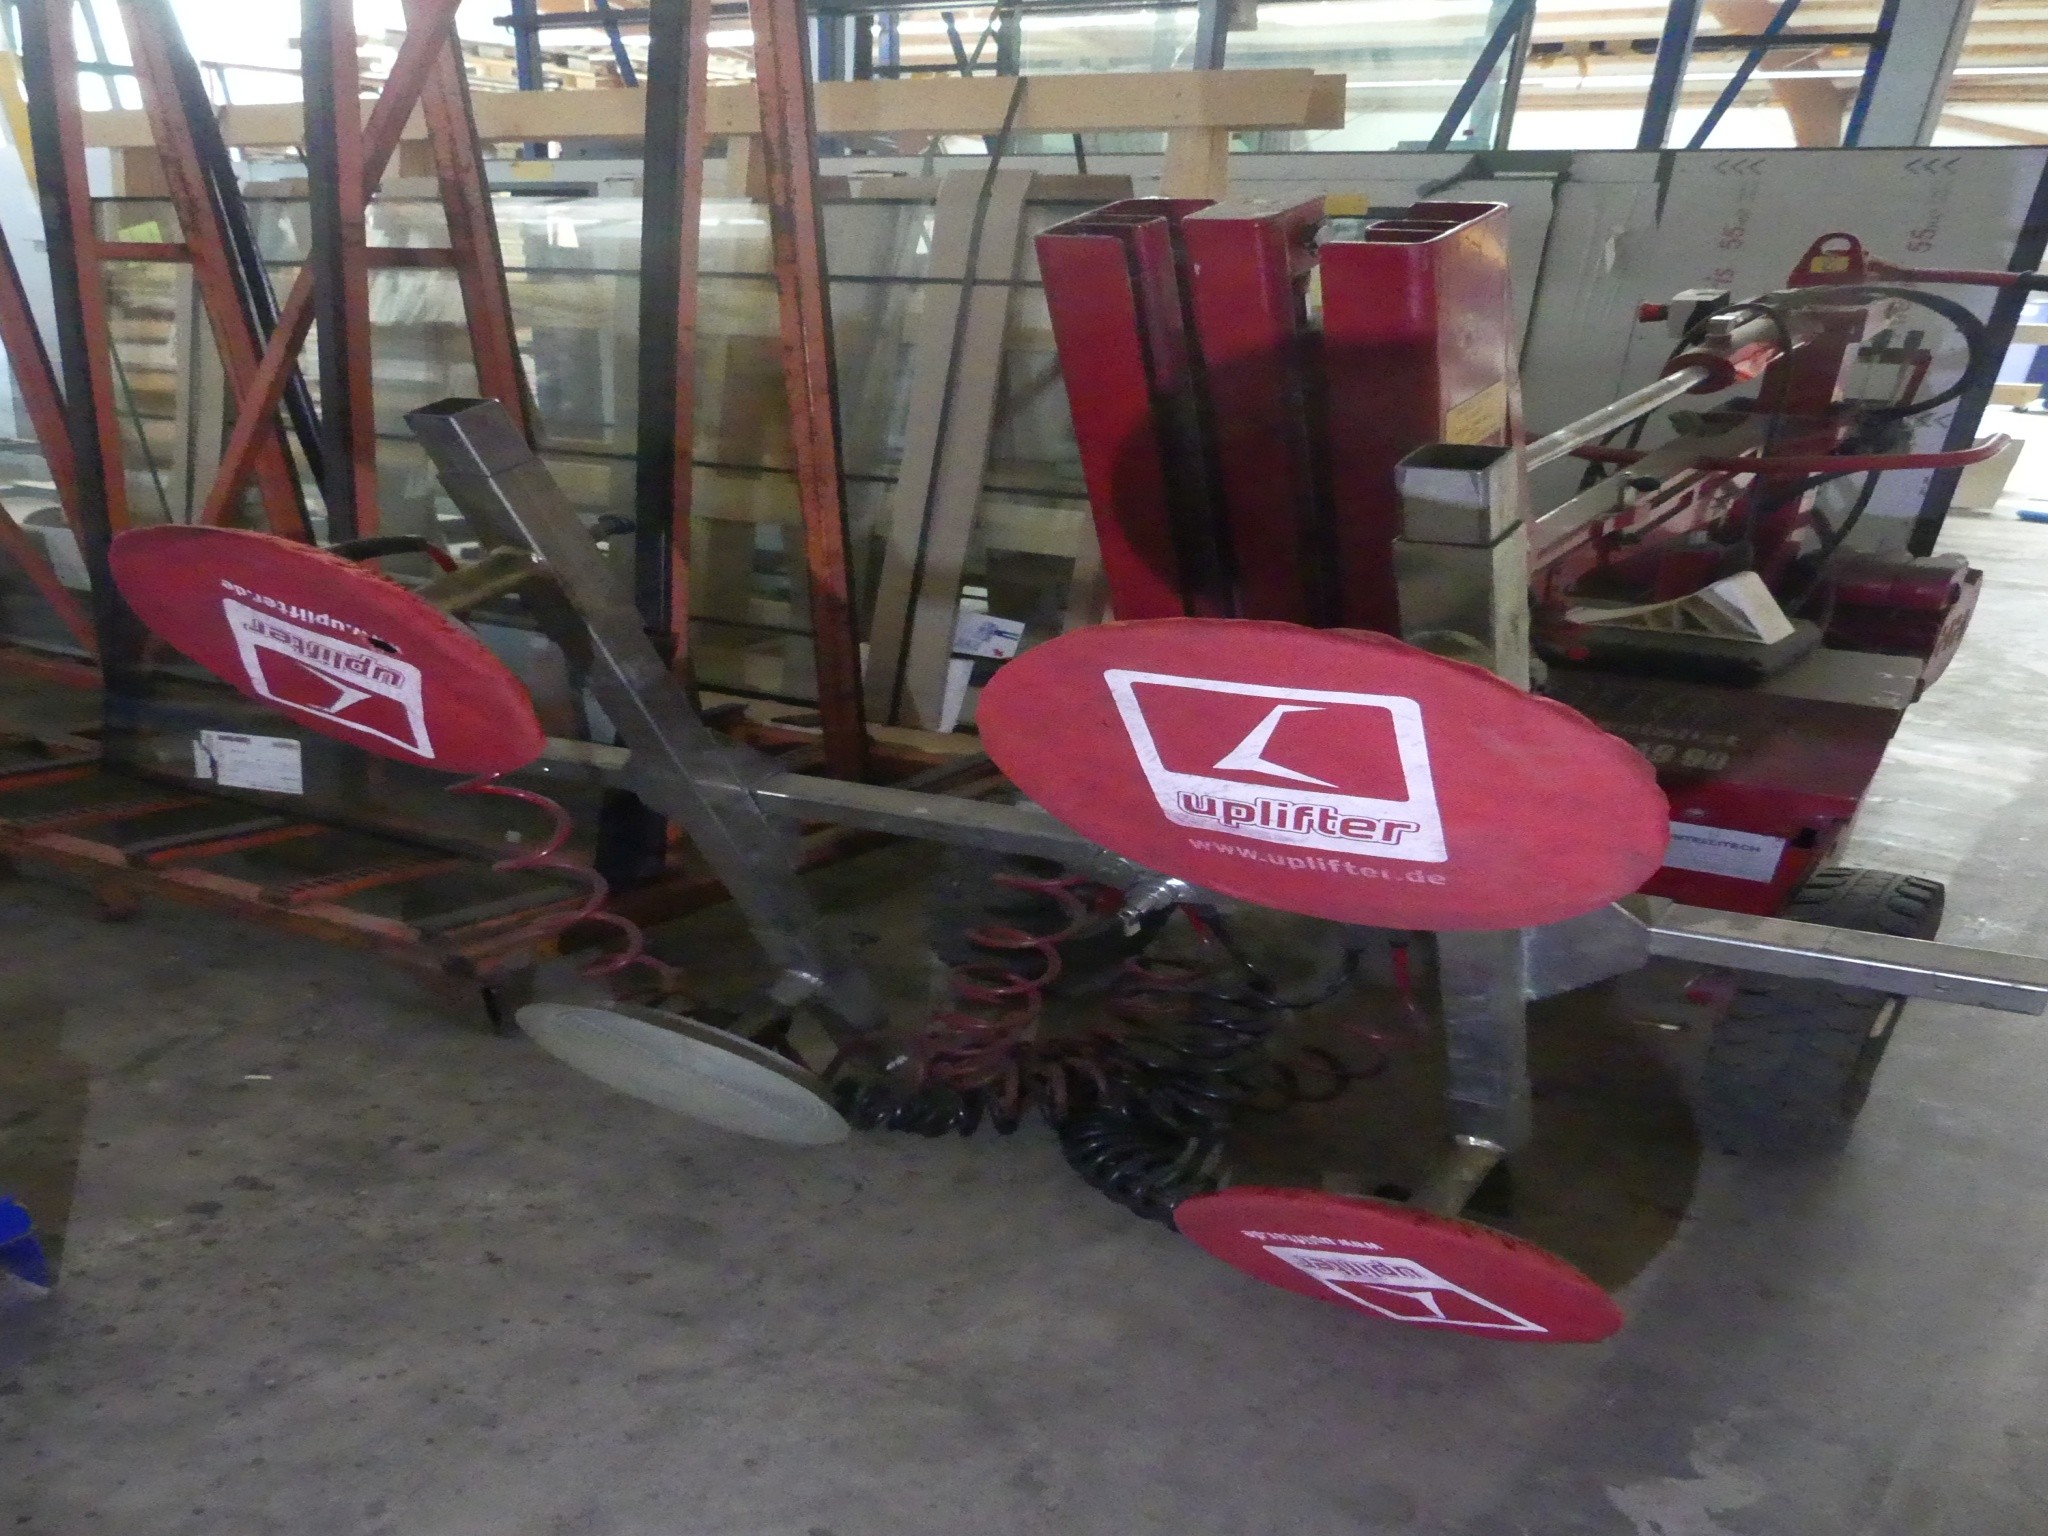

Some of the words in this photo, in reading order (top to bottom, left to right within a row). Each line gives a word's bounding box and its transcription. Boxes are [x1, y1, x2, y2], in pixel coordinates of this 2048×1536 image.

[243, 618, 406, 689] uplifter
[1178, 790, 1421, 845] uplifter
[1188, 838, 1447, 886] www.uplifter.de
